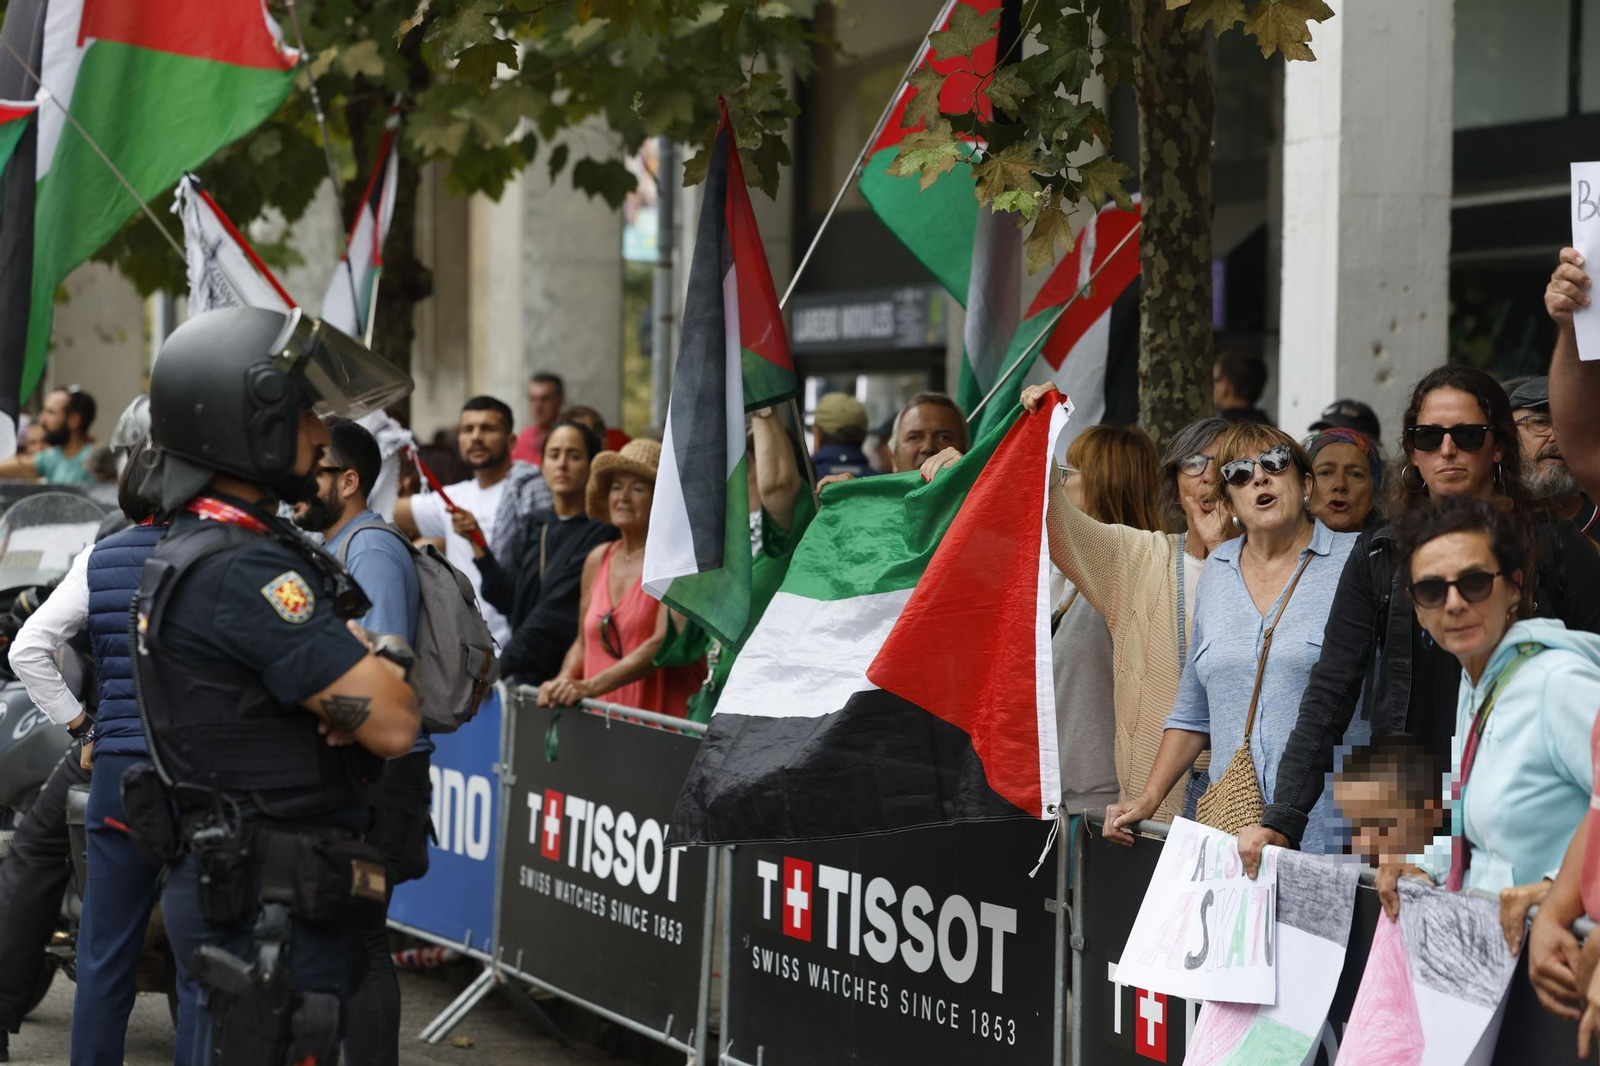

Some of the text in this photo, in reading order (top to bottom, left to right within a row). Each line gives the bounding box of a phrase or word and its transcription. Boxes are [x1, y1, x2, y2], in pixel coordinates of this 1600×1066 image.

[1577, 179, 1600, 222] B
[564, 794, 688, 903] TISSOT
[519, 864, 683, 945] SWISS WATCHES SINCE 1853
[818, 864, 1018, 995] TISSOT
[1136, 883, 1276, 972] ASKATU
[752, 945, 1016, 1046] SWISS WATCHES SINCE 1853
